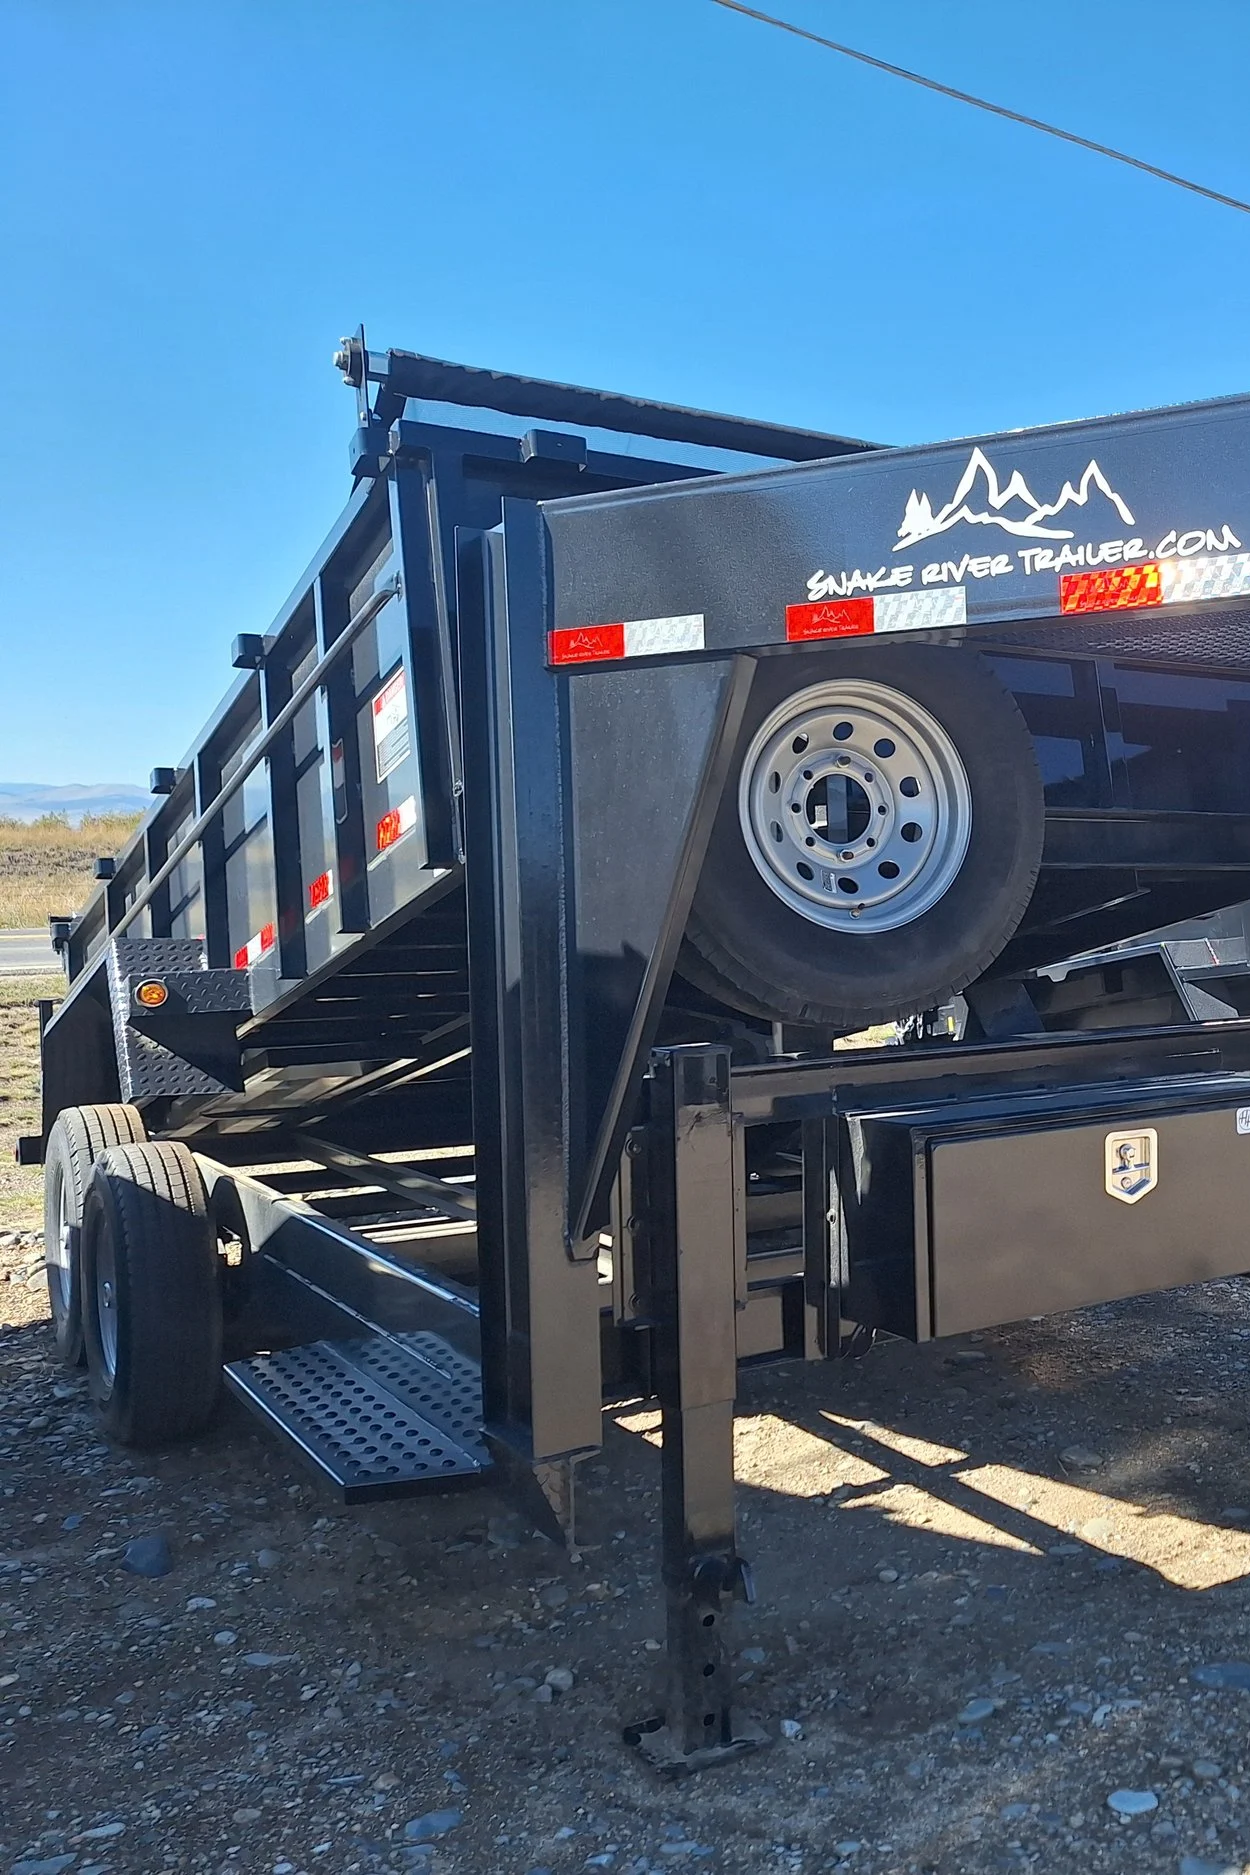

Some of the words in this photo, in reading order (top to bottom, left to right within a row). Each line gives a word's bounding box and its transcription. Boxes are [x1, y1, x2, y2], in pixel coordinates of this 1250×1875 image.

[806, 566, 913, 600] SNAKE
[921, 553, 1014, 584] RIVER
[1018, 524, 1242, 575] TRAILER.COM
